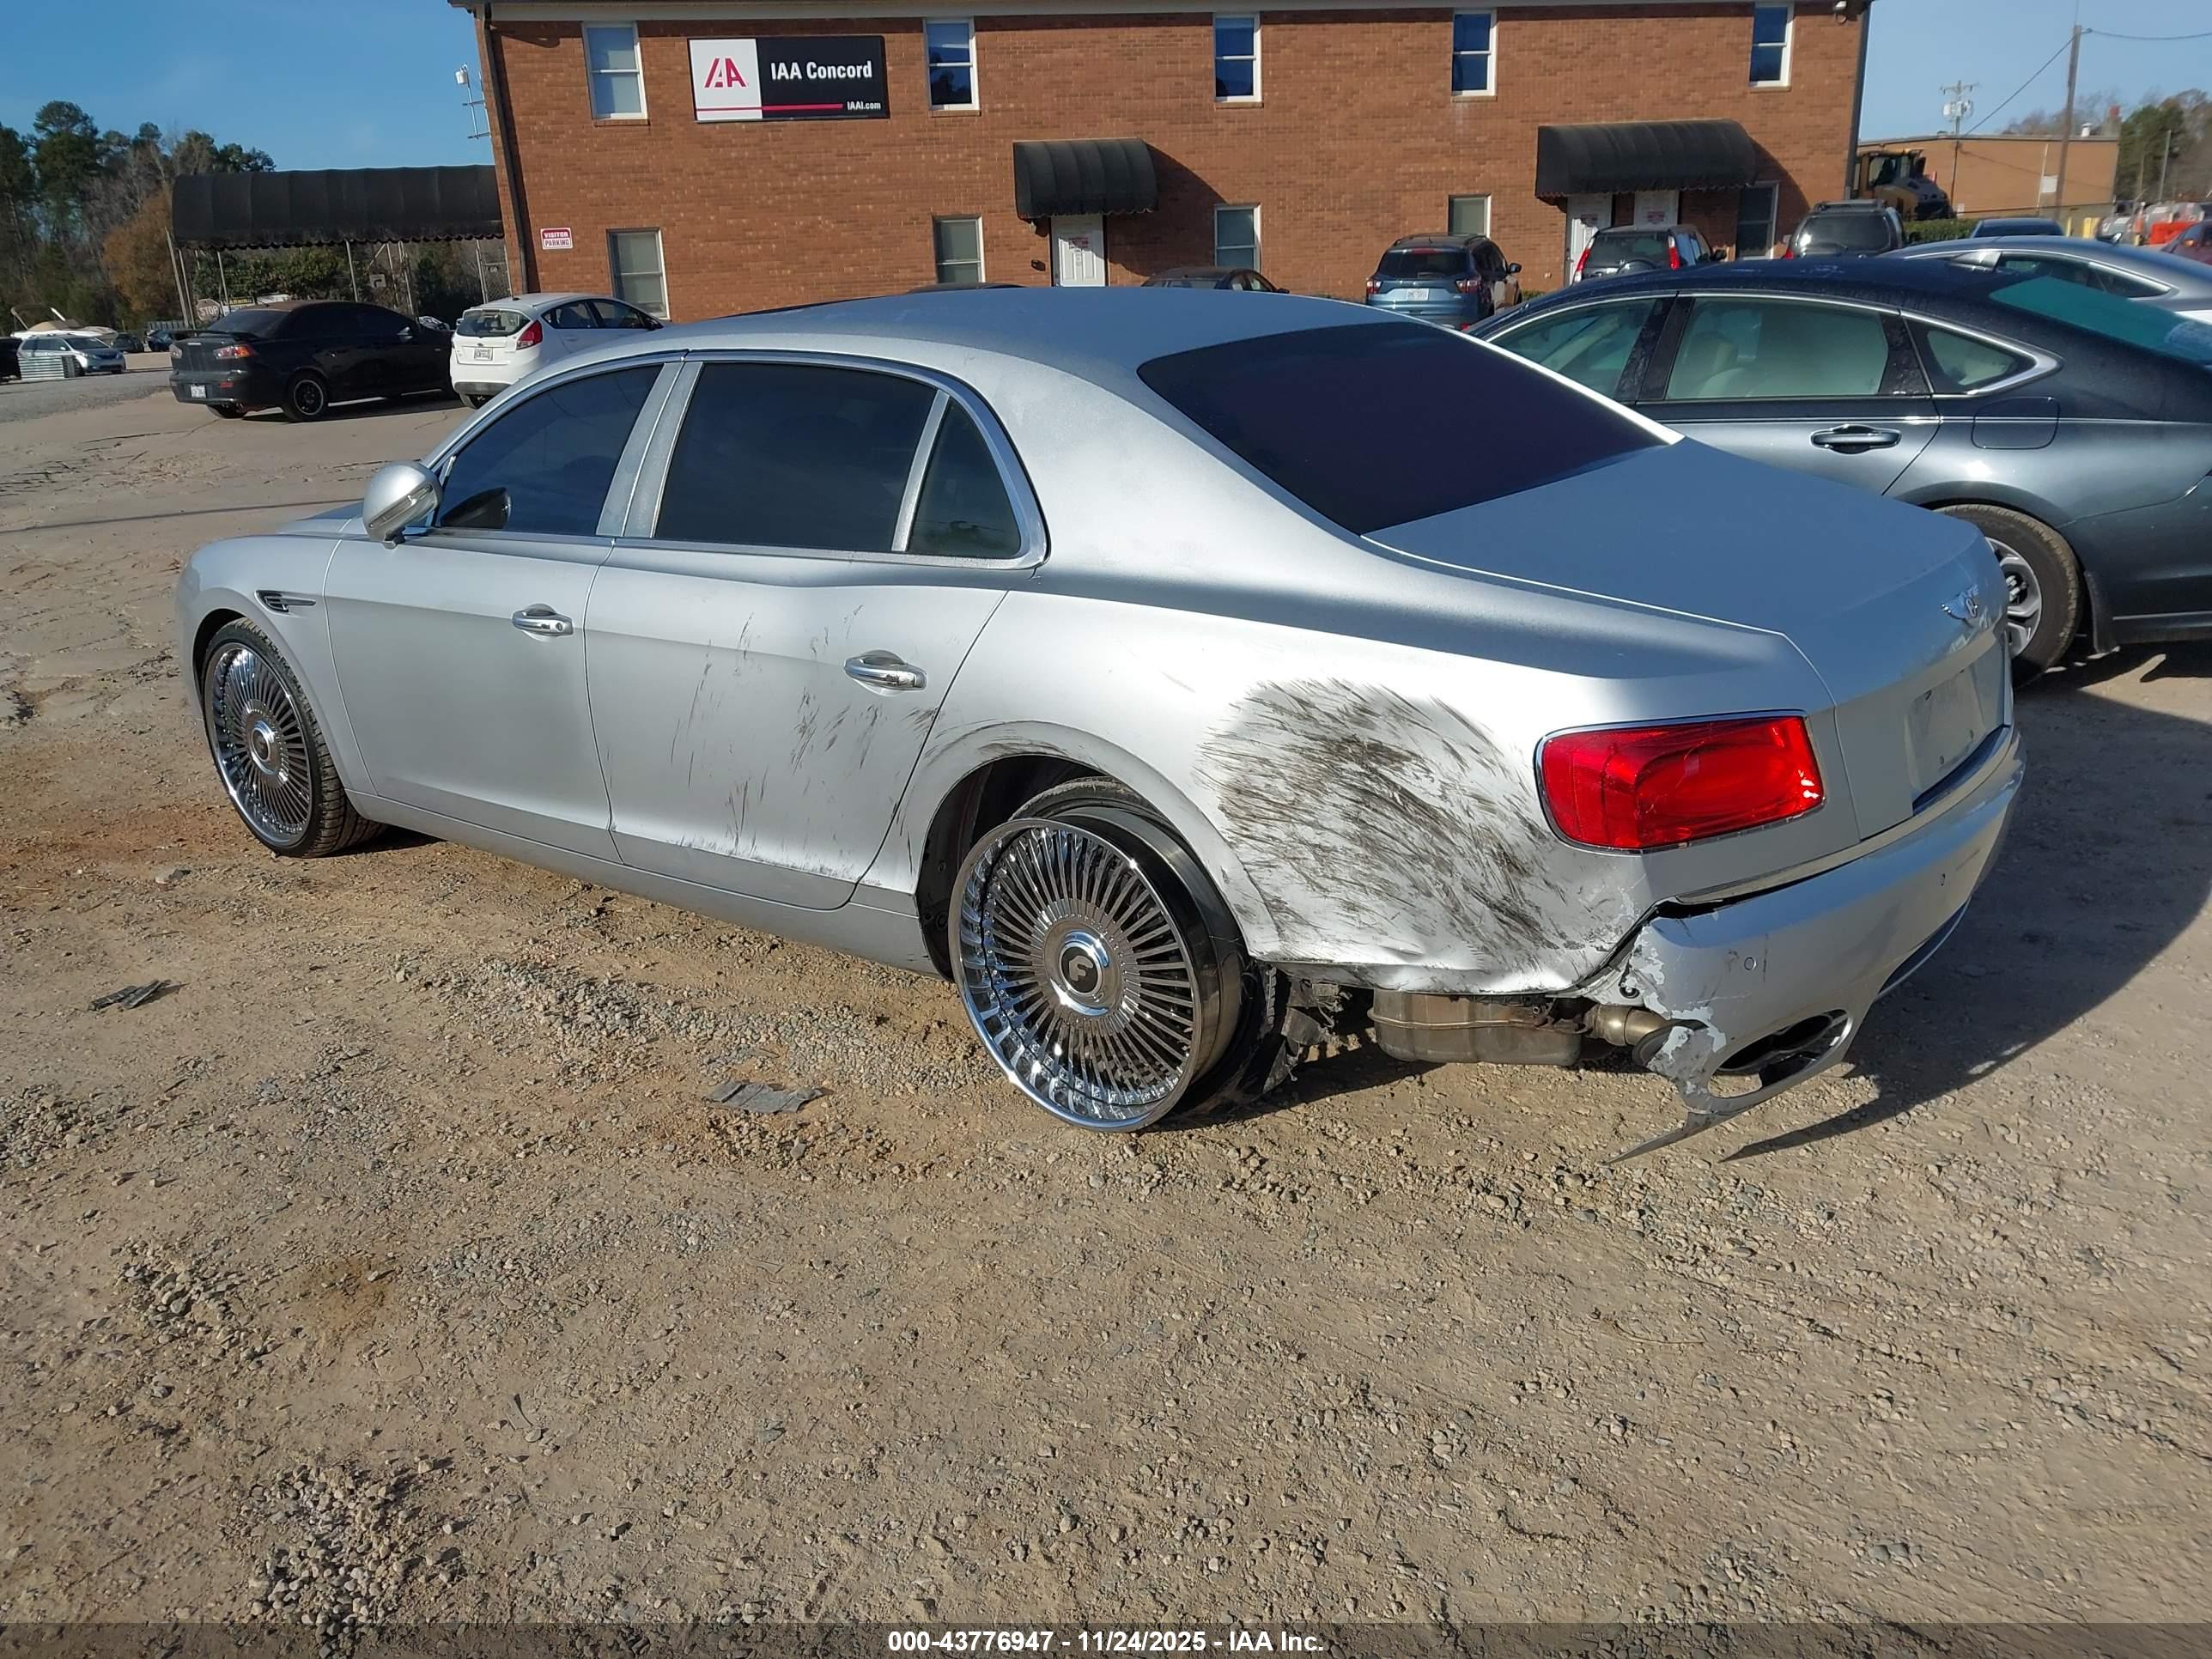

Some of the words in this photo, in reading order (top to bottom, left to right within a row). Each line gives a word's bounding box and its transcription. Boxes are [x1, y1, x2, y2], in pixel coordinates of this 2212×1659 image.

[771, 62, 803, 81] IAA
[806, 60, 872, 80] Concord
[847, 100, 882, 112] IAAI.com
[199, 306, 219, 316] STOP
